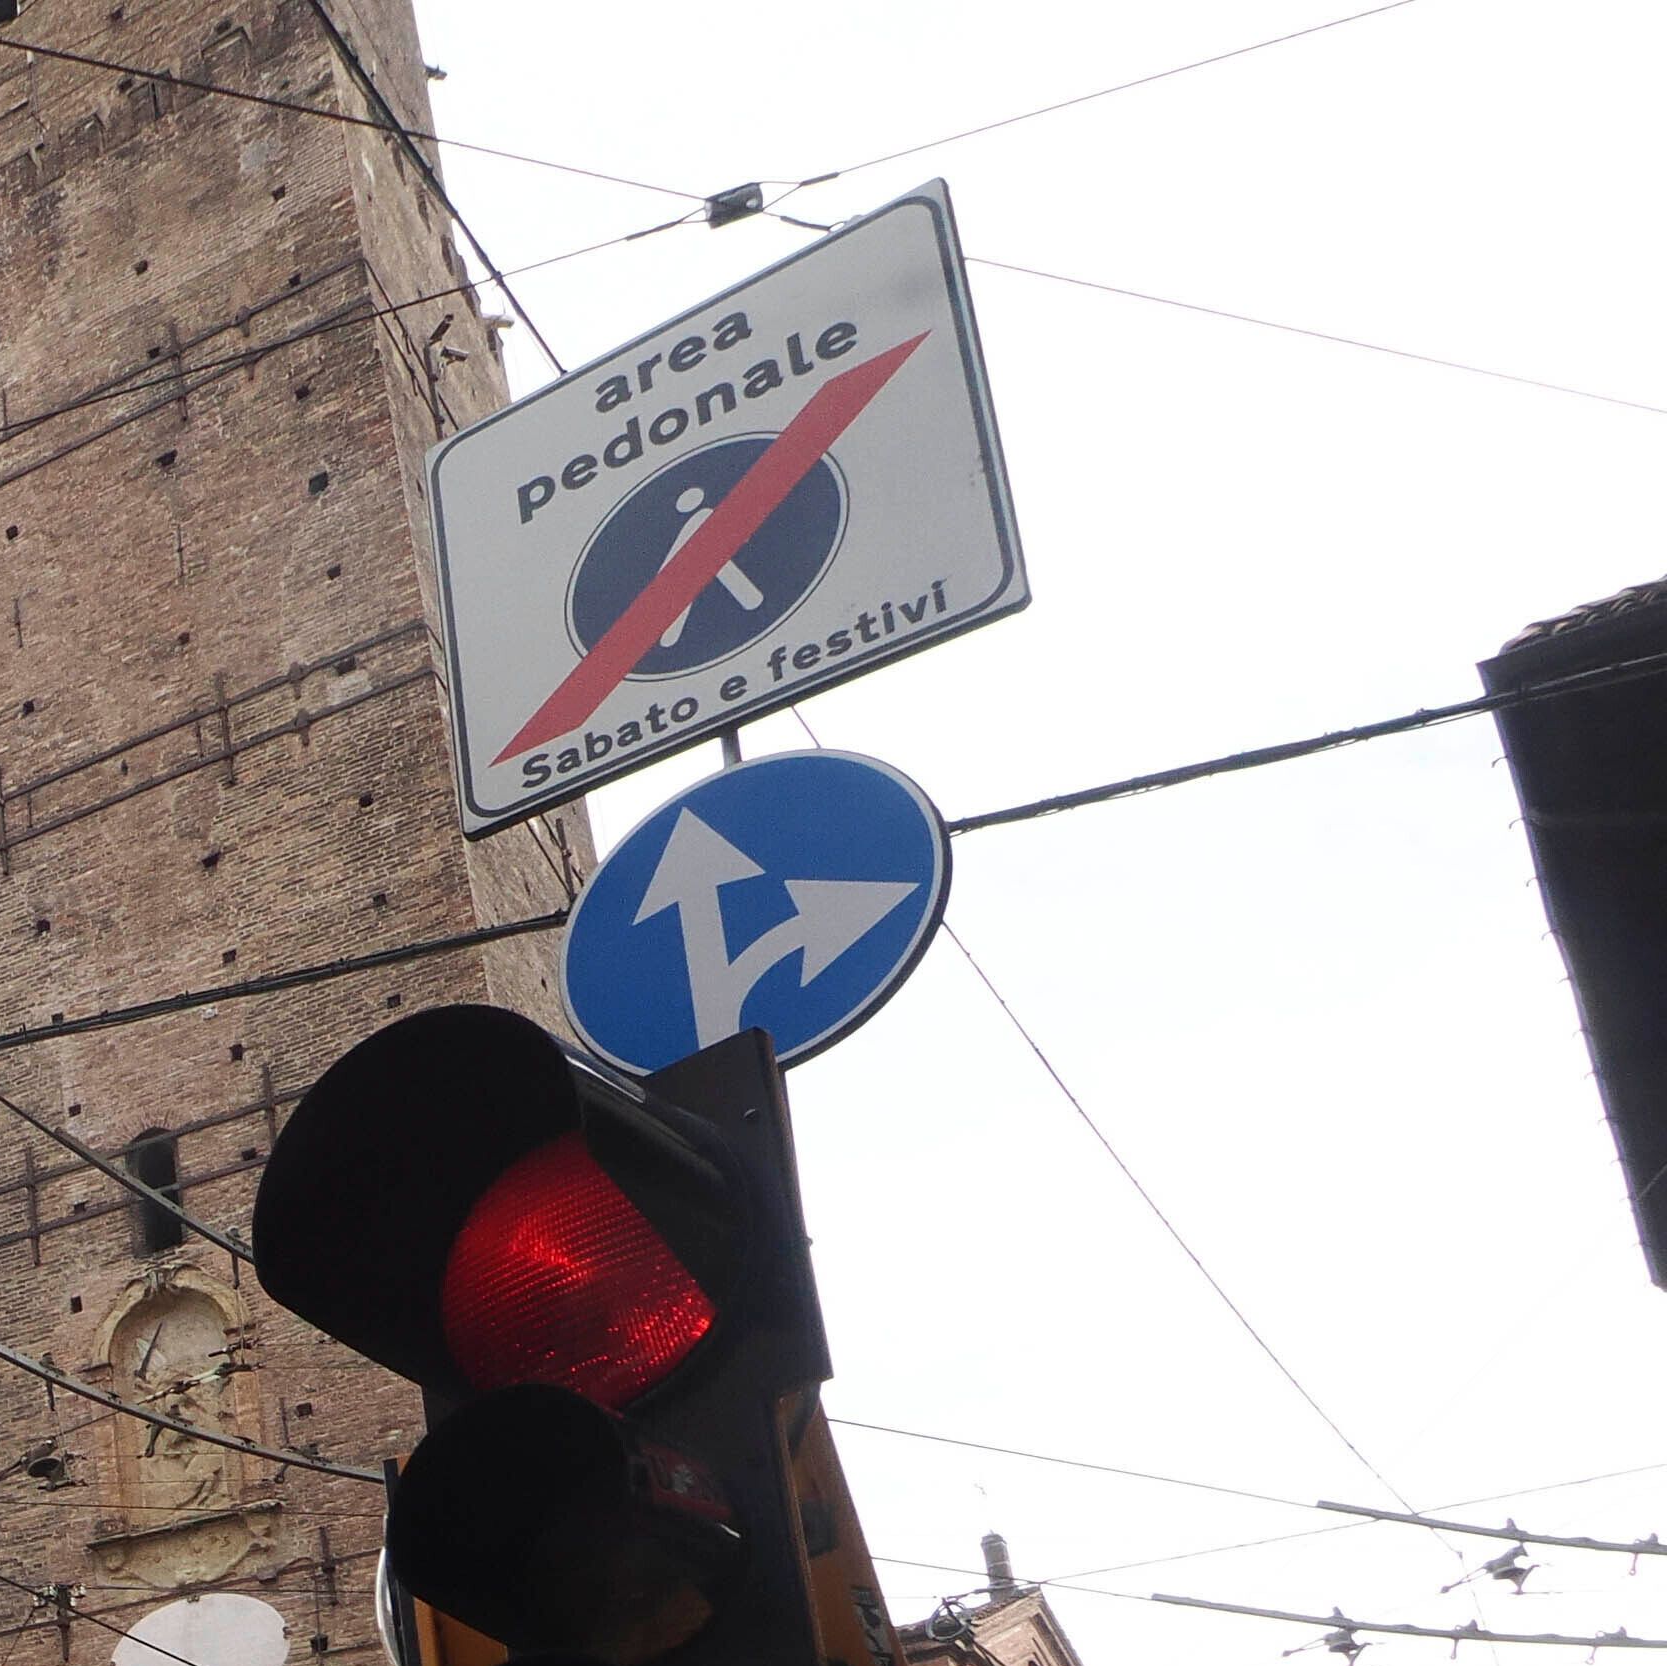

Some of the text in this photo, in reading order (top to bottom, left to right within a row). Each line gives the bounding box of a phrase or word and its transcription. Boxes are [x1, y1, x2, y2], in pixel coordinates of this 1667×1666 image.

[516, 321, 858, 524] pedonale
[594, 310, 753, 412] area
[520, 580, 948, 789] Sabato e festivi
